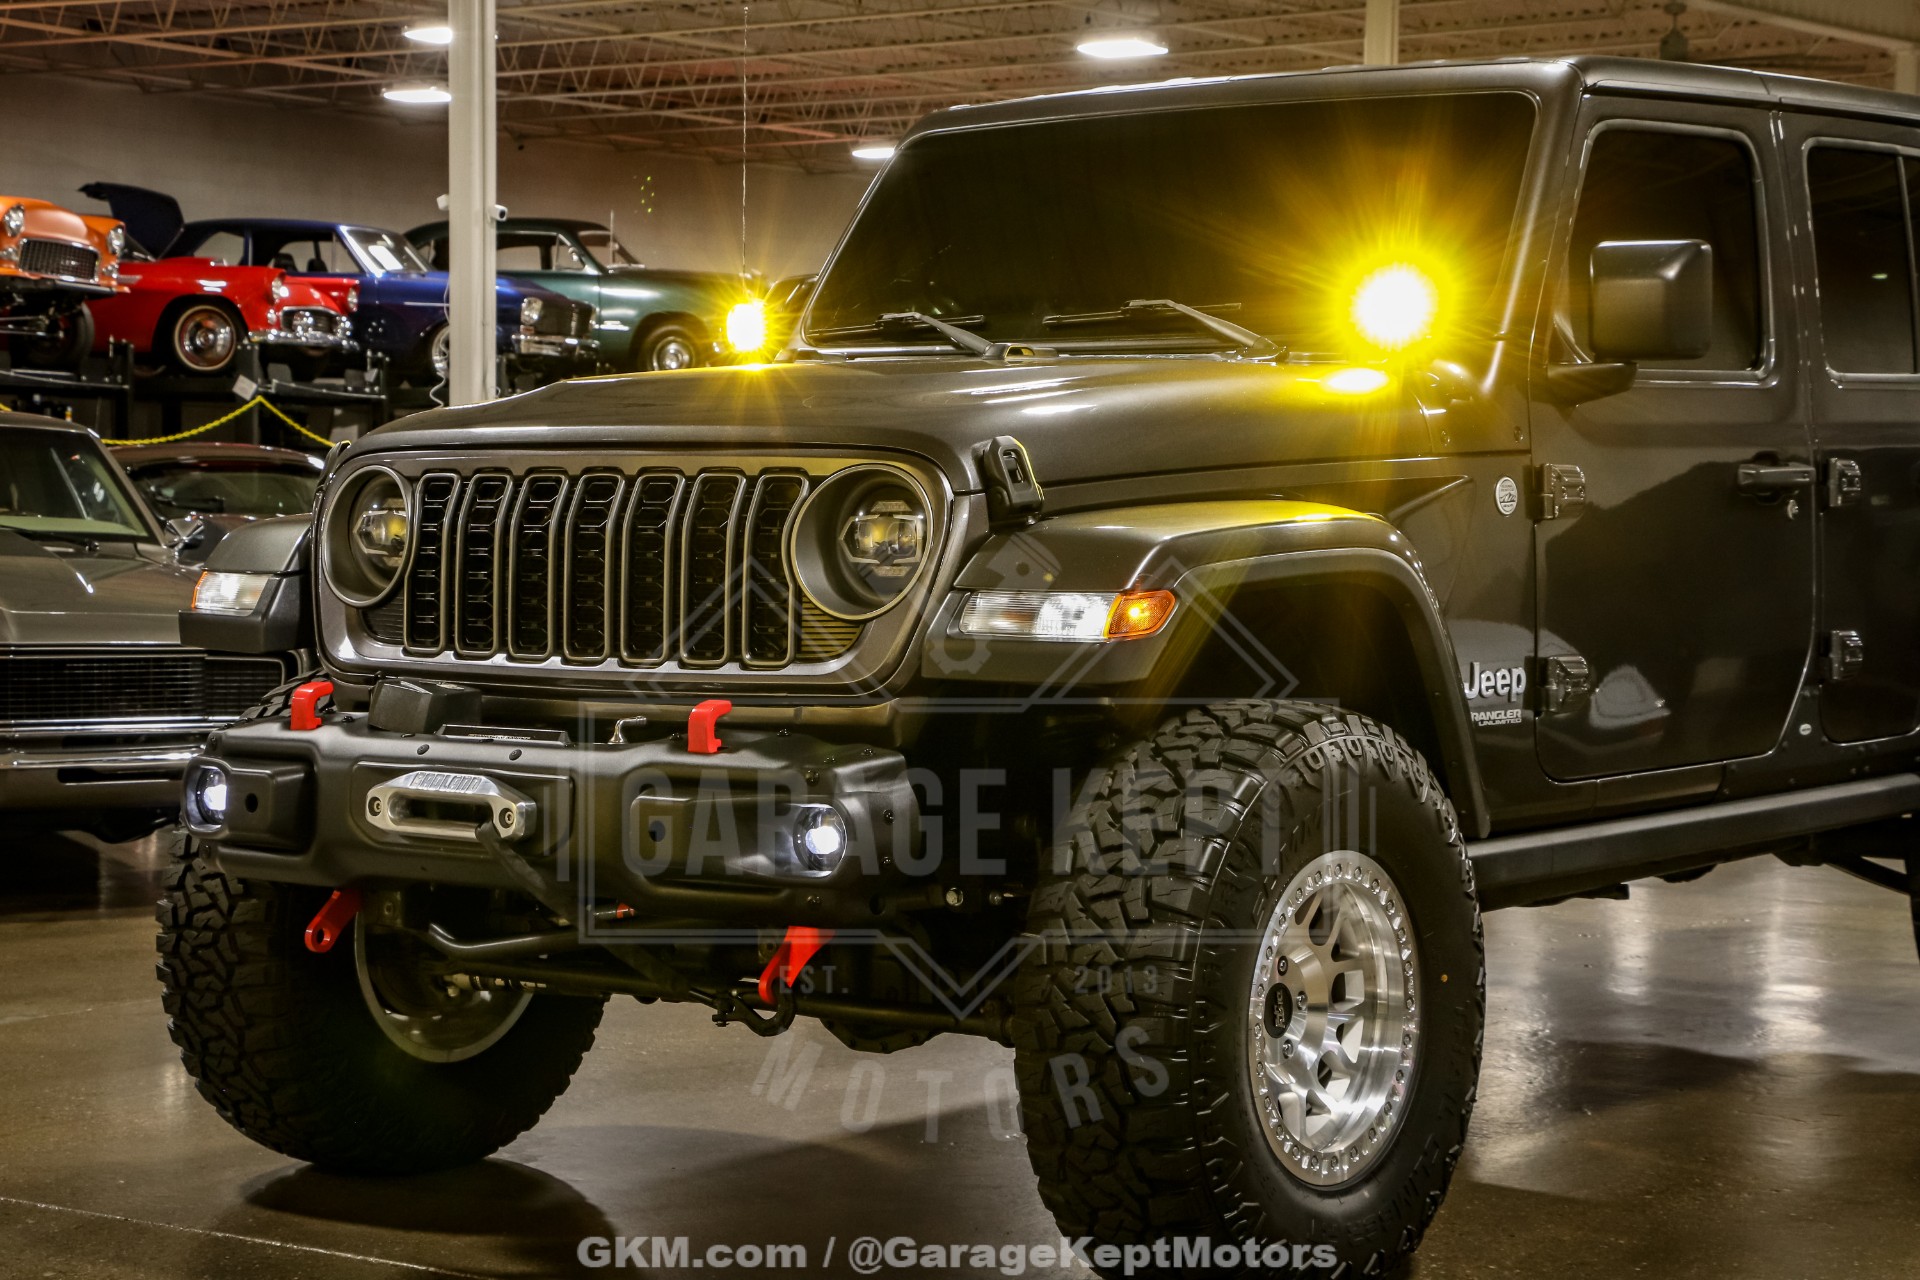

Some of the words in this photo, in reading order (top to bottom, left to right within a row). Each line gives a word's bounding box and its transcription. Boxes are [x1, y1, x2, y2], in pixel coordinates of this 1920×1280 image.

[1462, 661, 1527, 702] Jeep
[1470, 708, 1522, 722] RANGLER
[1478, 718, 1522, 727] UNLIMITED
